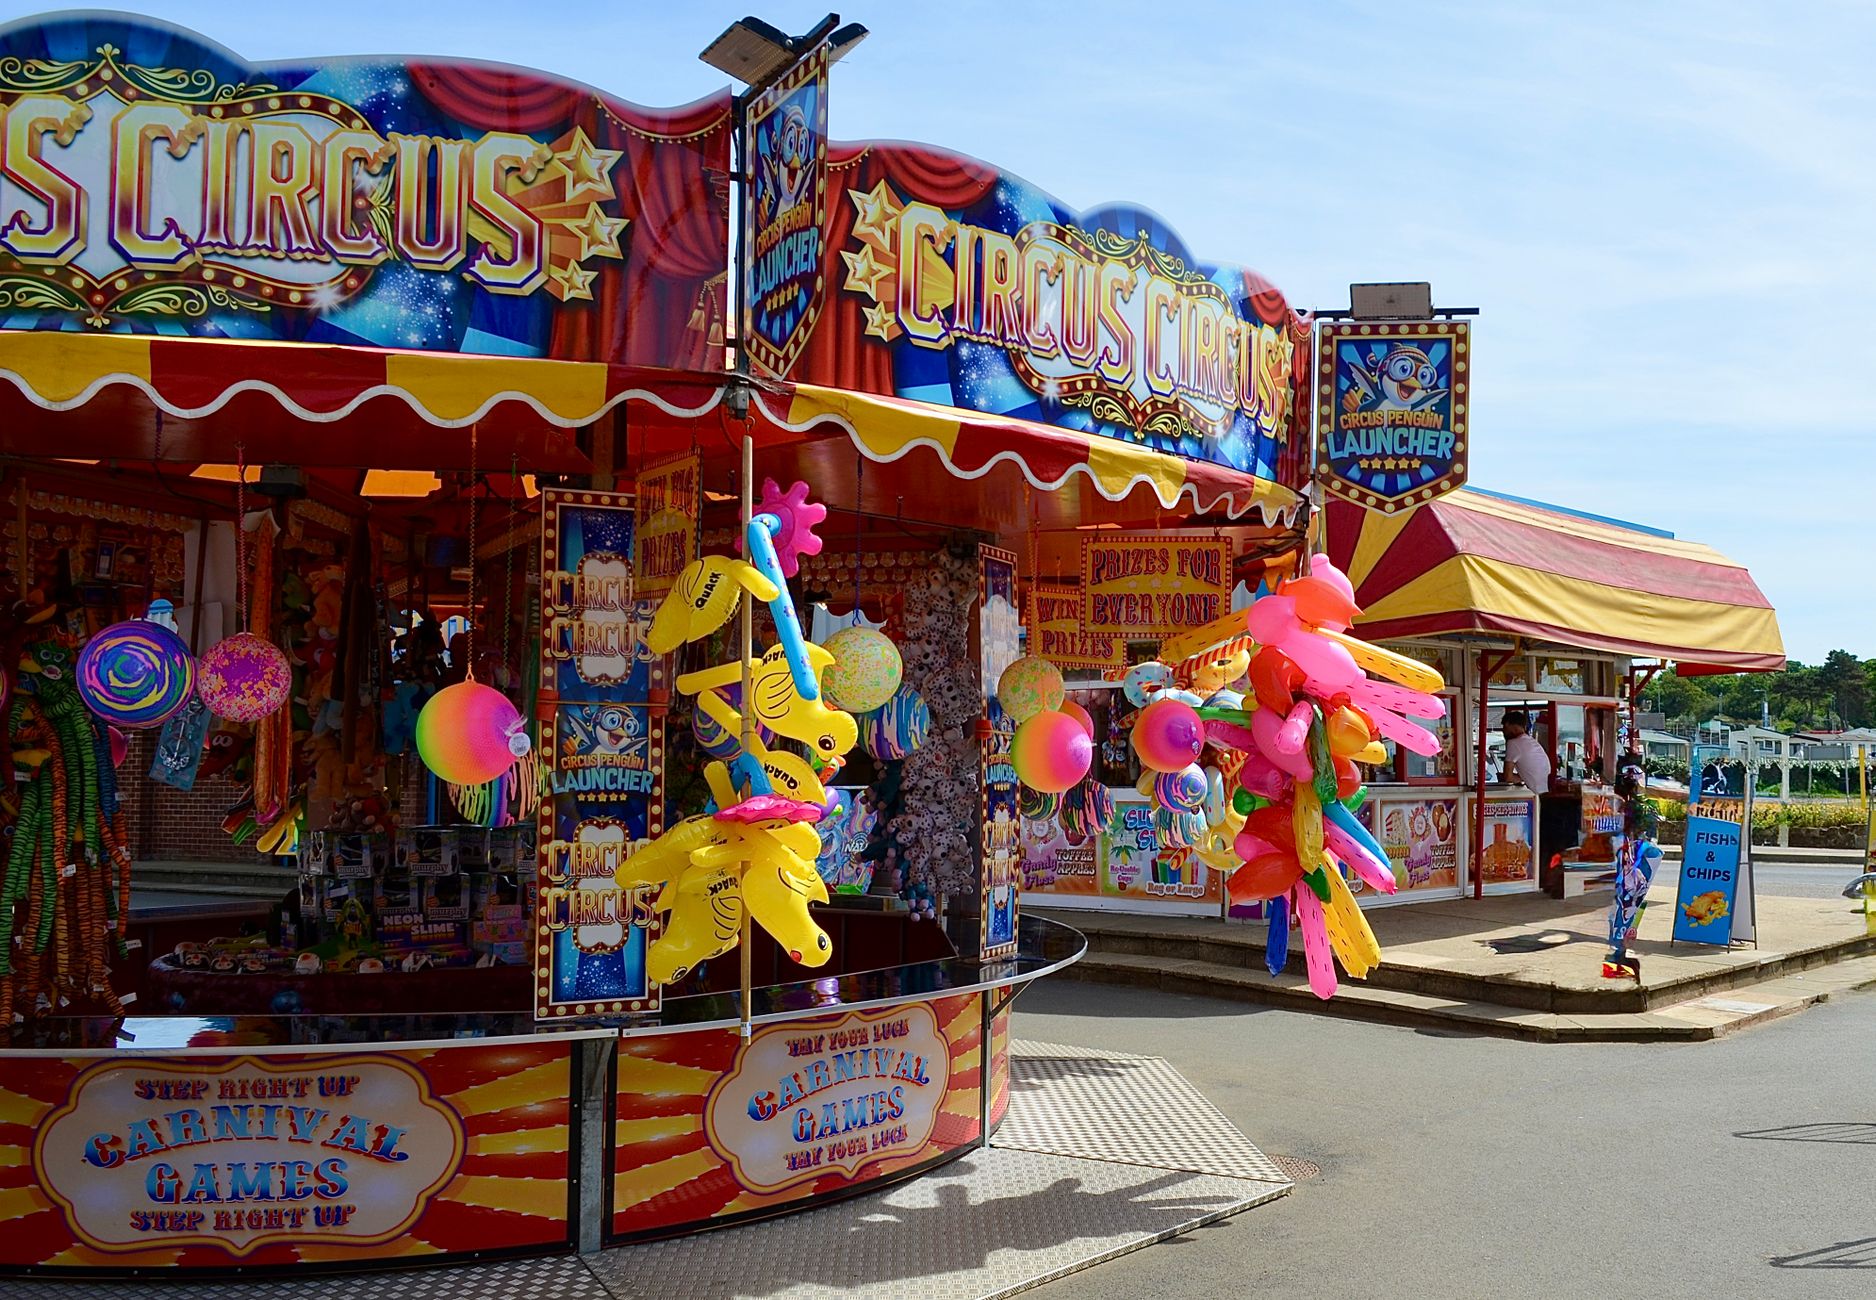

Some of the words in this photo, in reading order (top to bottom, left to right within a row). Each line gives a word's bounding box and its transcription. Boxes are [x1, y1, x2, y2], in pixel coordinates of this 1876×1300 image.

[108, 100, 554, 297] CIRCUS
[750, 227, 818, 307] LAUNCHER
[896, 201, 1137, 393] CIRCUS
[1144, 273, 1281, 439] CIRCUS
[1326, 426, 1456, 460] LAUNCHER
[641, 528, 687, 578] PRIZES
[1090, 547, 1170, 586] PRIZES
[1176, 547, 1222, 586] FOR
[1036, 597, 1079, 624] WIN
[1091, 592, 1220, 626] EVERYONE
[550, 616, 657, 664] CIRCUS
[1040, 629, 1114, 659] PRIZES
[550, 767, 654, 795] LAUNCHER
[1695, 832, 1729, 846] FISH
[1055, 849, 1094, 863] TOFFEE
[1056, 863, 1096, 876] APPLES
[1705, 851, 1715, 862] &
[1148, 883, 1165, 895] Reg
[1687, 867, 1731, 882] CHIPS
[383, 913, 423, 926] NEON
[546, 887, 655, 930] CIRCUS
[411, 922, 455, 935] SLIME
[829, 1025, 868, 1048] YOUR
[134, 1079, 206, 1100] STEP
[217, 1077, 314, 1100] RIGHT
[317, 1075, 360, 1098] UP
[747, 1047, 930, 1122] CARNIVAL
[791, 1085, 905, 1144] GAMES
[81, 1103, 409, 1169] CARNIVAL
[827, 1138, 868, 1163] YOUR
[144, 1158, 350, 1204] GAMES
[130, 1210, 204, 1233] STEP
[213, 1207, 311, 1231] RIGHT
[313, 1205, 357, 1227] UP
